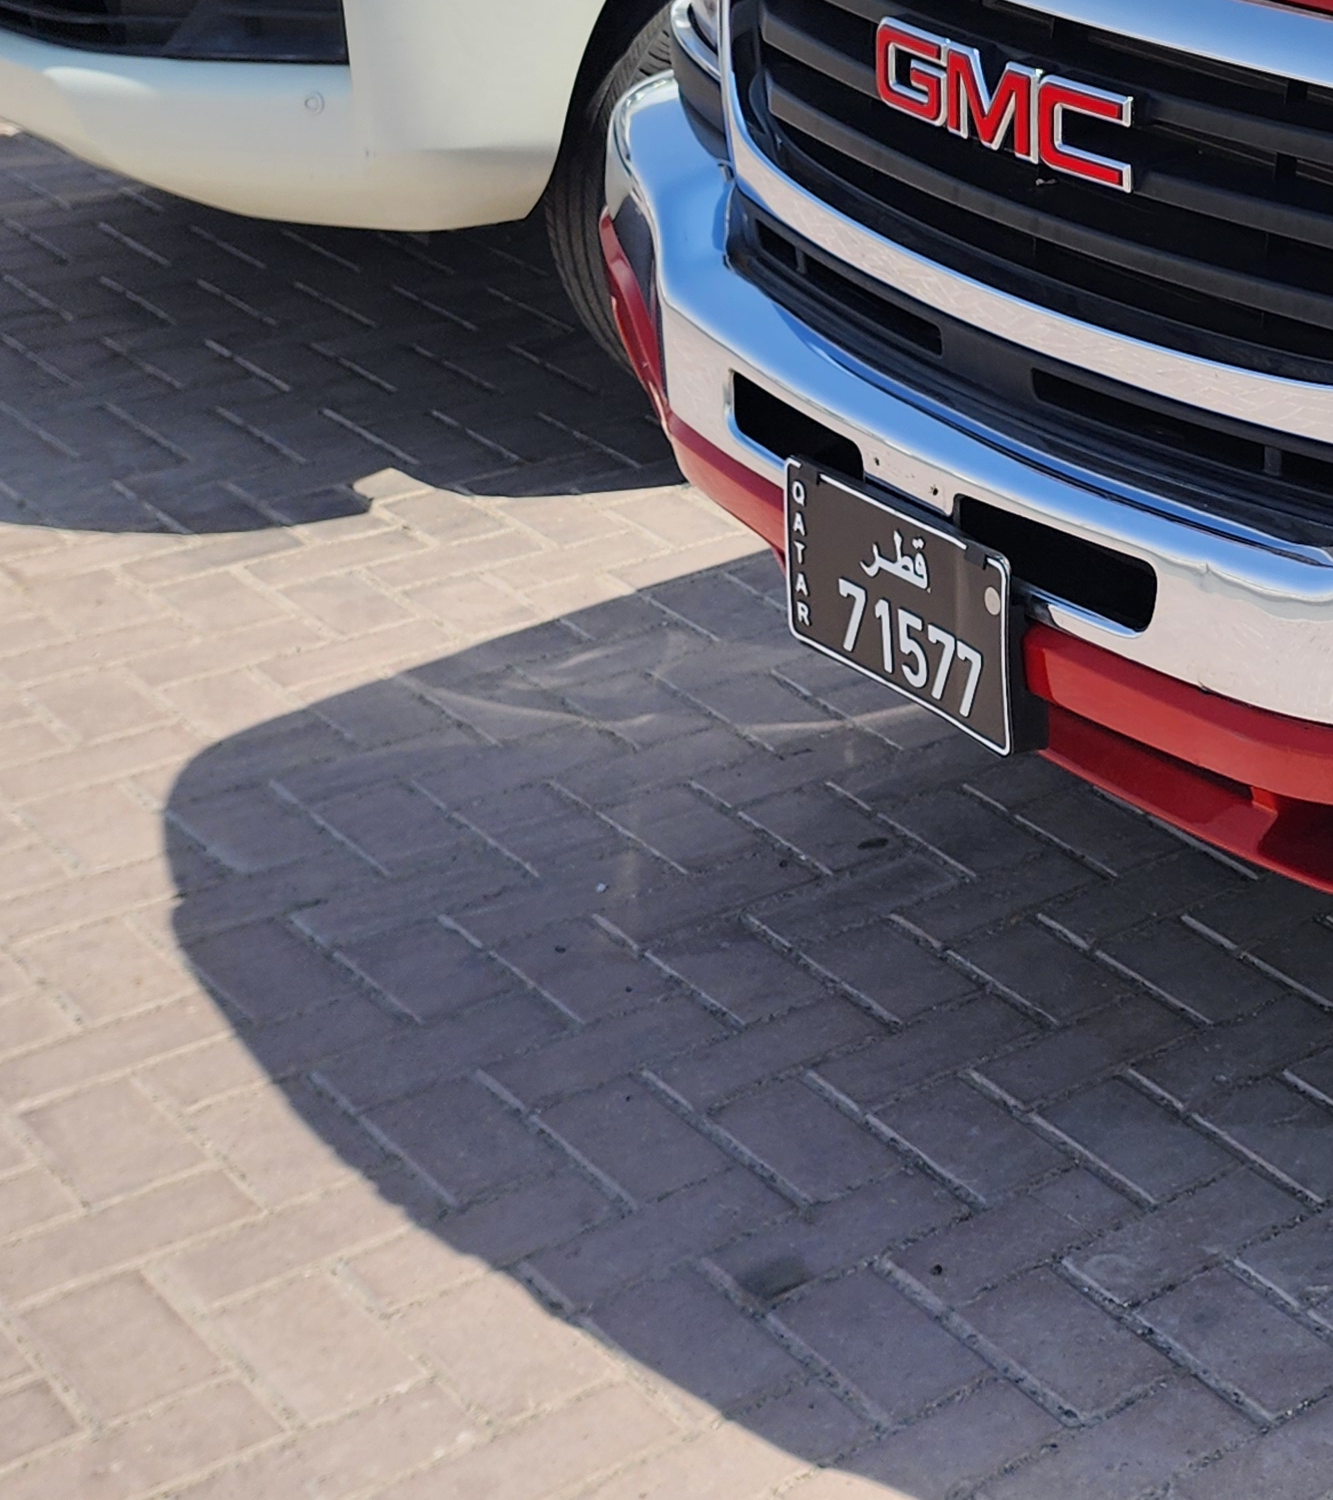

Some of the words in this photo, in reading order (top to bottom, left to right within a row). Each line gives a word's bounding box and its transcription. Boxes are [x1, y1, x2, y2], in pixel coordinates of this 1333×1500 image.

[875, 15, 1134, 194] GMC
[791, 481, 811, 627] QATAR
[859, 528, 929, 588] قطر
[838, 577, 983, 718] 71577
